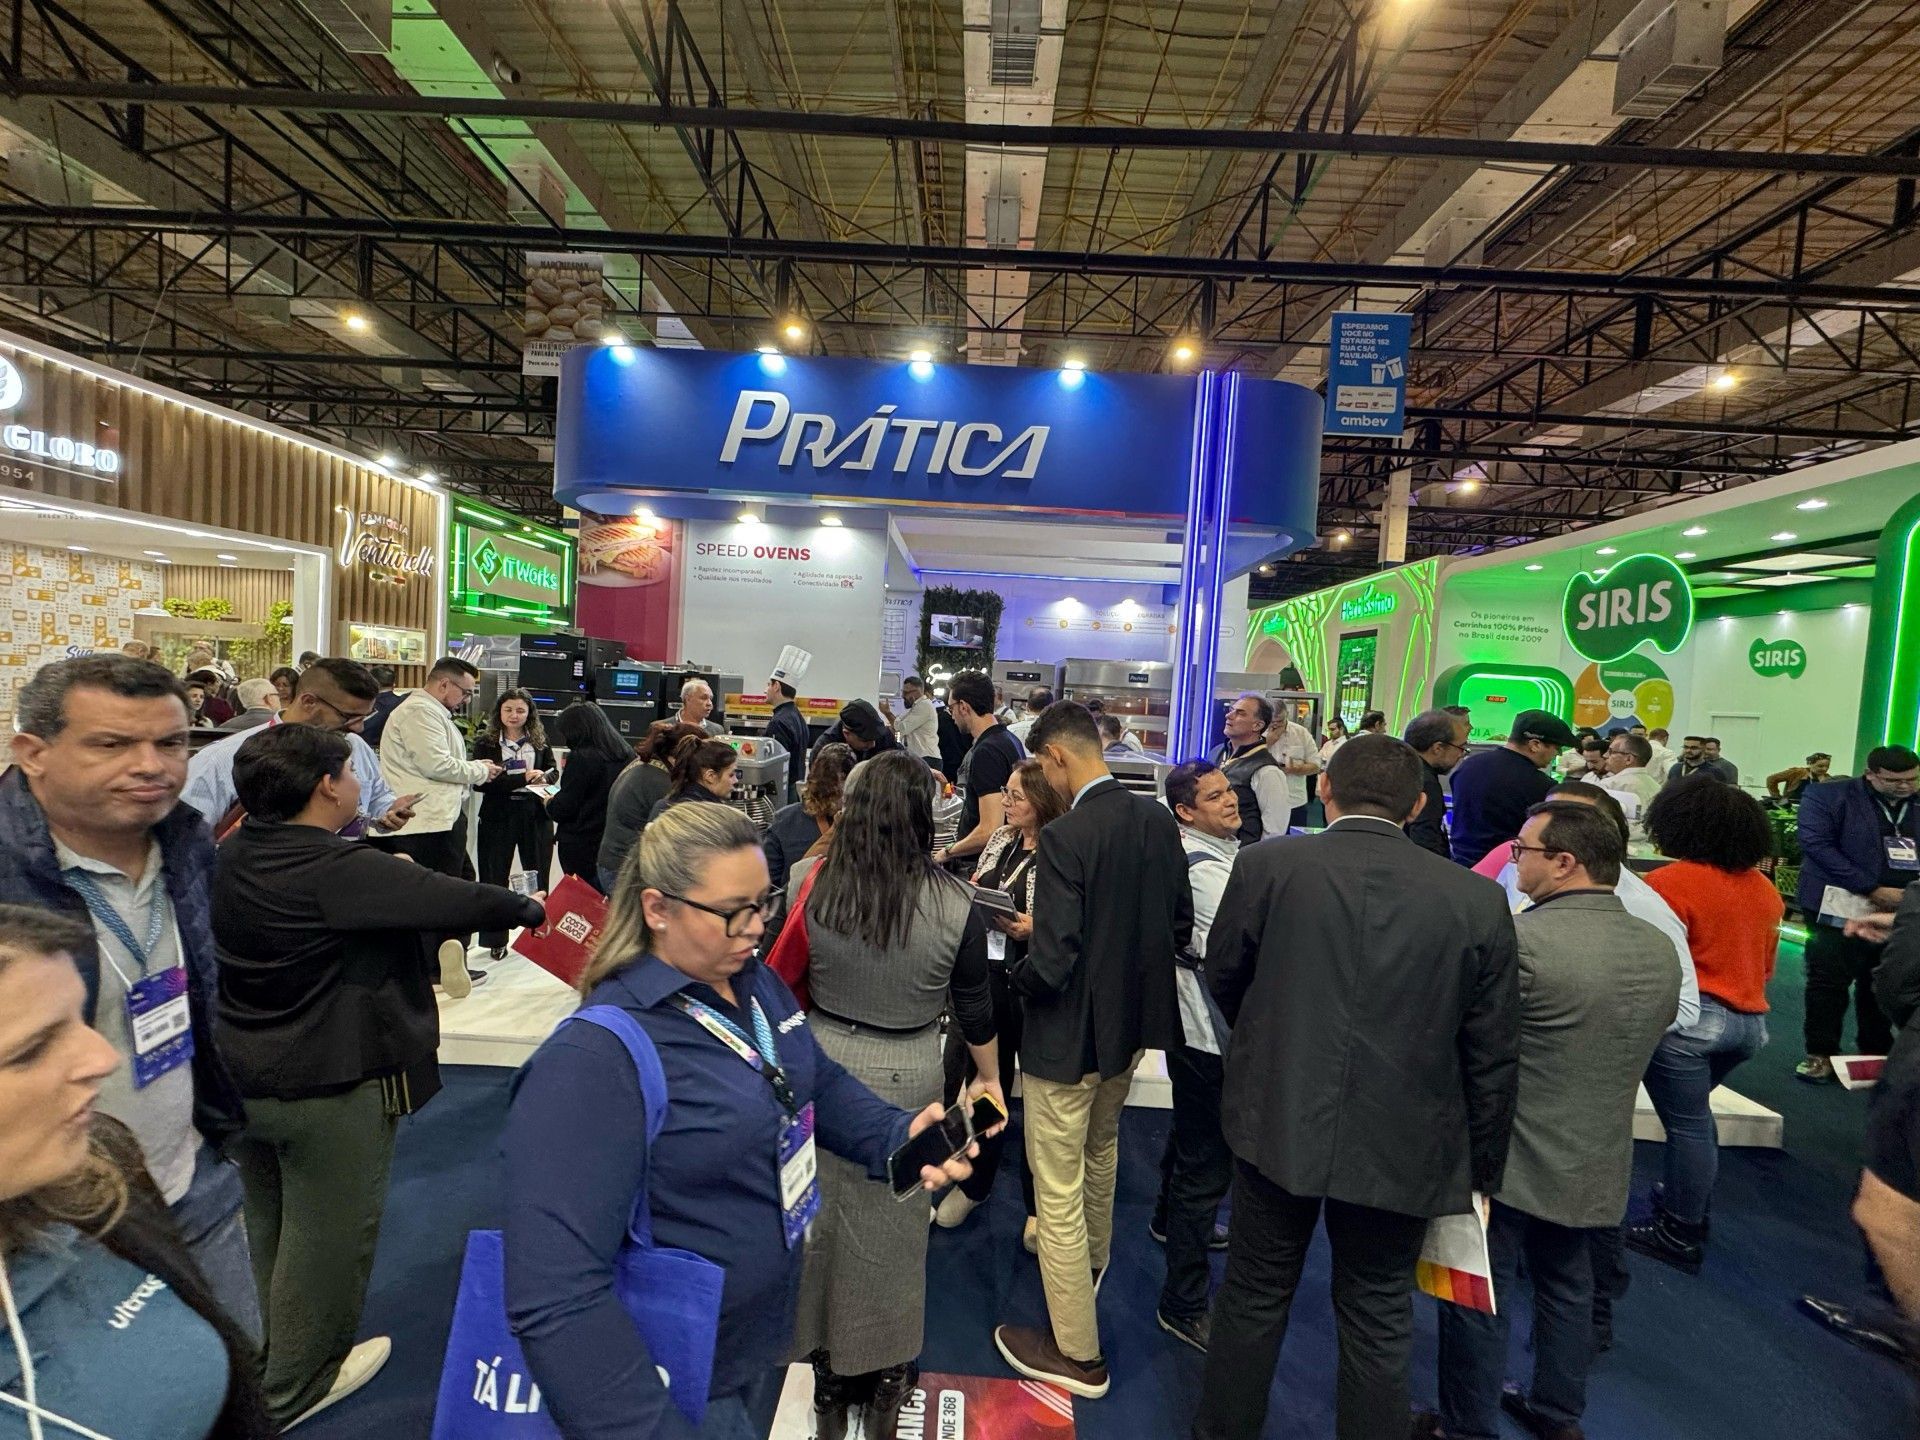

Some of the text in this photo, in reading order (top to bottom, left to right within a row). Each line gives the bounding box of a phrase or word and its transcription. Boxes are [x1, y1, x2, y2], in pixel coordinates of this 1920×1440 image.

[1341, 323, 1389, 331] ESPERAMOS
[1340, 337, 1376, 345] ESTANDE
[1340, 415, 1389, 427] ambev
[3, 424, 119, 473] GLOBO
[0, 465, 34, 481] 954
[696, 543, 811, 561] SPEED OVENS
[698, 565, 722, 575] Rapidez
[797, 570, 825, 580] Agilidade
[697, 574, 730, 583] Qualidade
[1576, 580, 1673, 631] SIRIS
[1471, 611, 1482, 619] Os
[1483, 612, 1520, 621] pioneiros
[1453, 620, 1549, 634] Carrinhos 100% Plástico
[1471, 632, 1494, 640] Brasil
[1495, 633, 1519, 642] desde
[1520, 635, 1542, 643] 2009
[1754, 648, 1802, 668] SIRIS
[1611, 699, 1635, 709] SIRIS
[560, 921, 584, 940] LAVOS
[565, 916, 588, 933] COSTA
[473, 1356, 502, 1411] TÁ
[943, 1396, 957, 1416] 368
